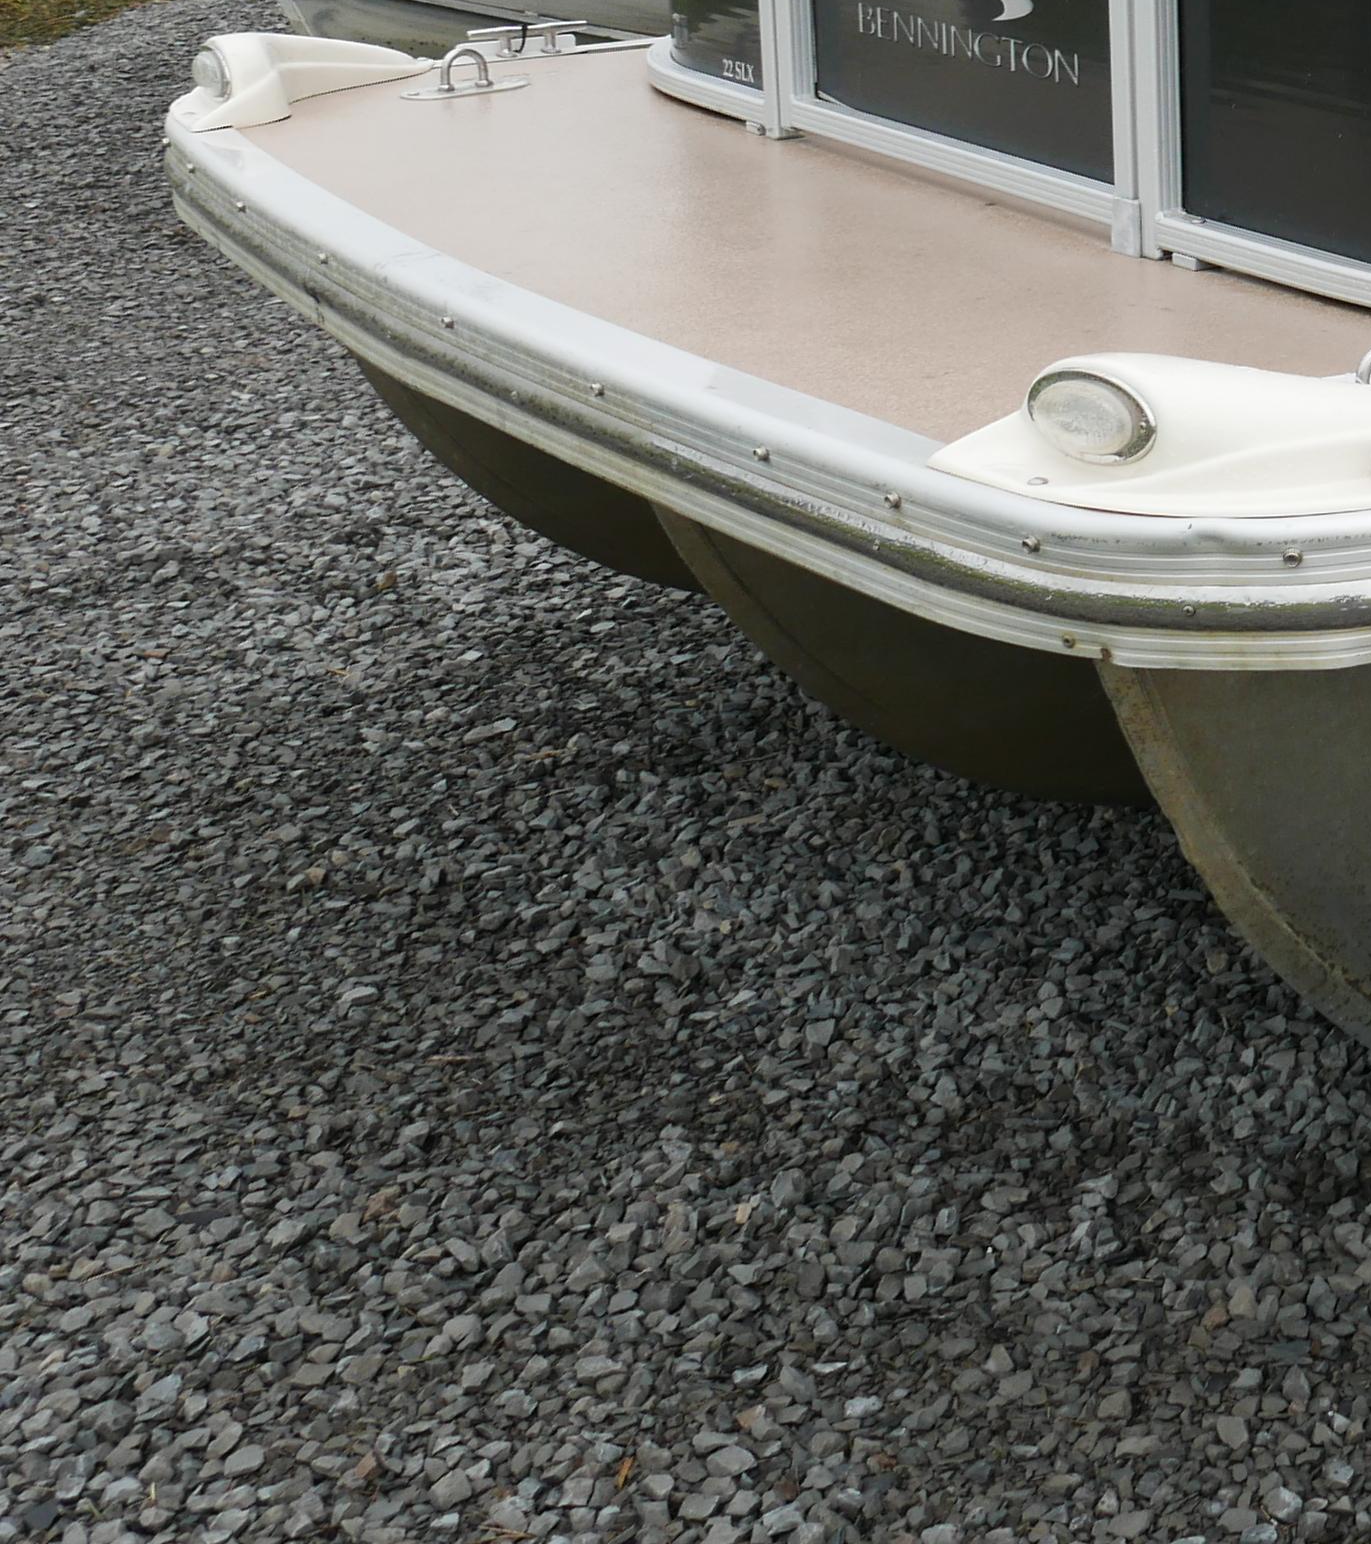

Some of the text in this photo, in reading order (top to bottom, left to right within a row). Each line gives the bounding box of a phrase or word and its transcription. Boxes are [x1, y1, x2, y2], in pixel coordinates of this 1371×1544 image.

[722, 58, 755, 83] 22 SLX
[857, 2, 1079, 86] BENNINGTON
